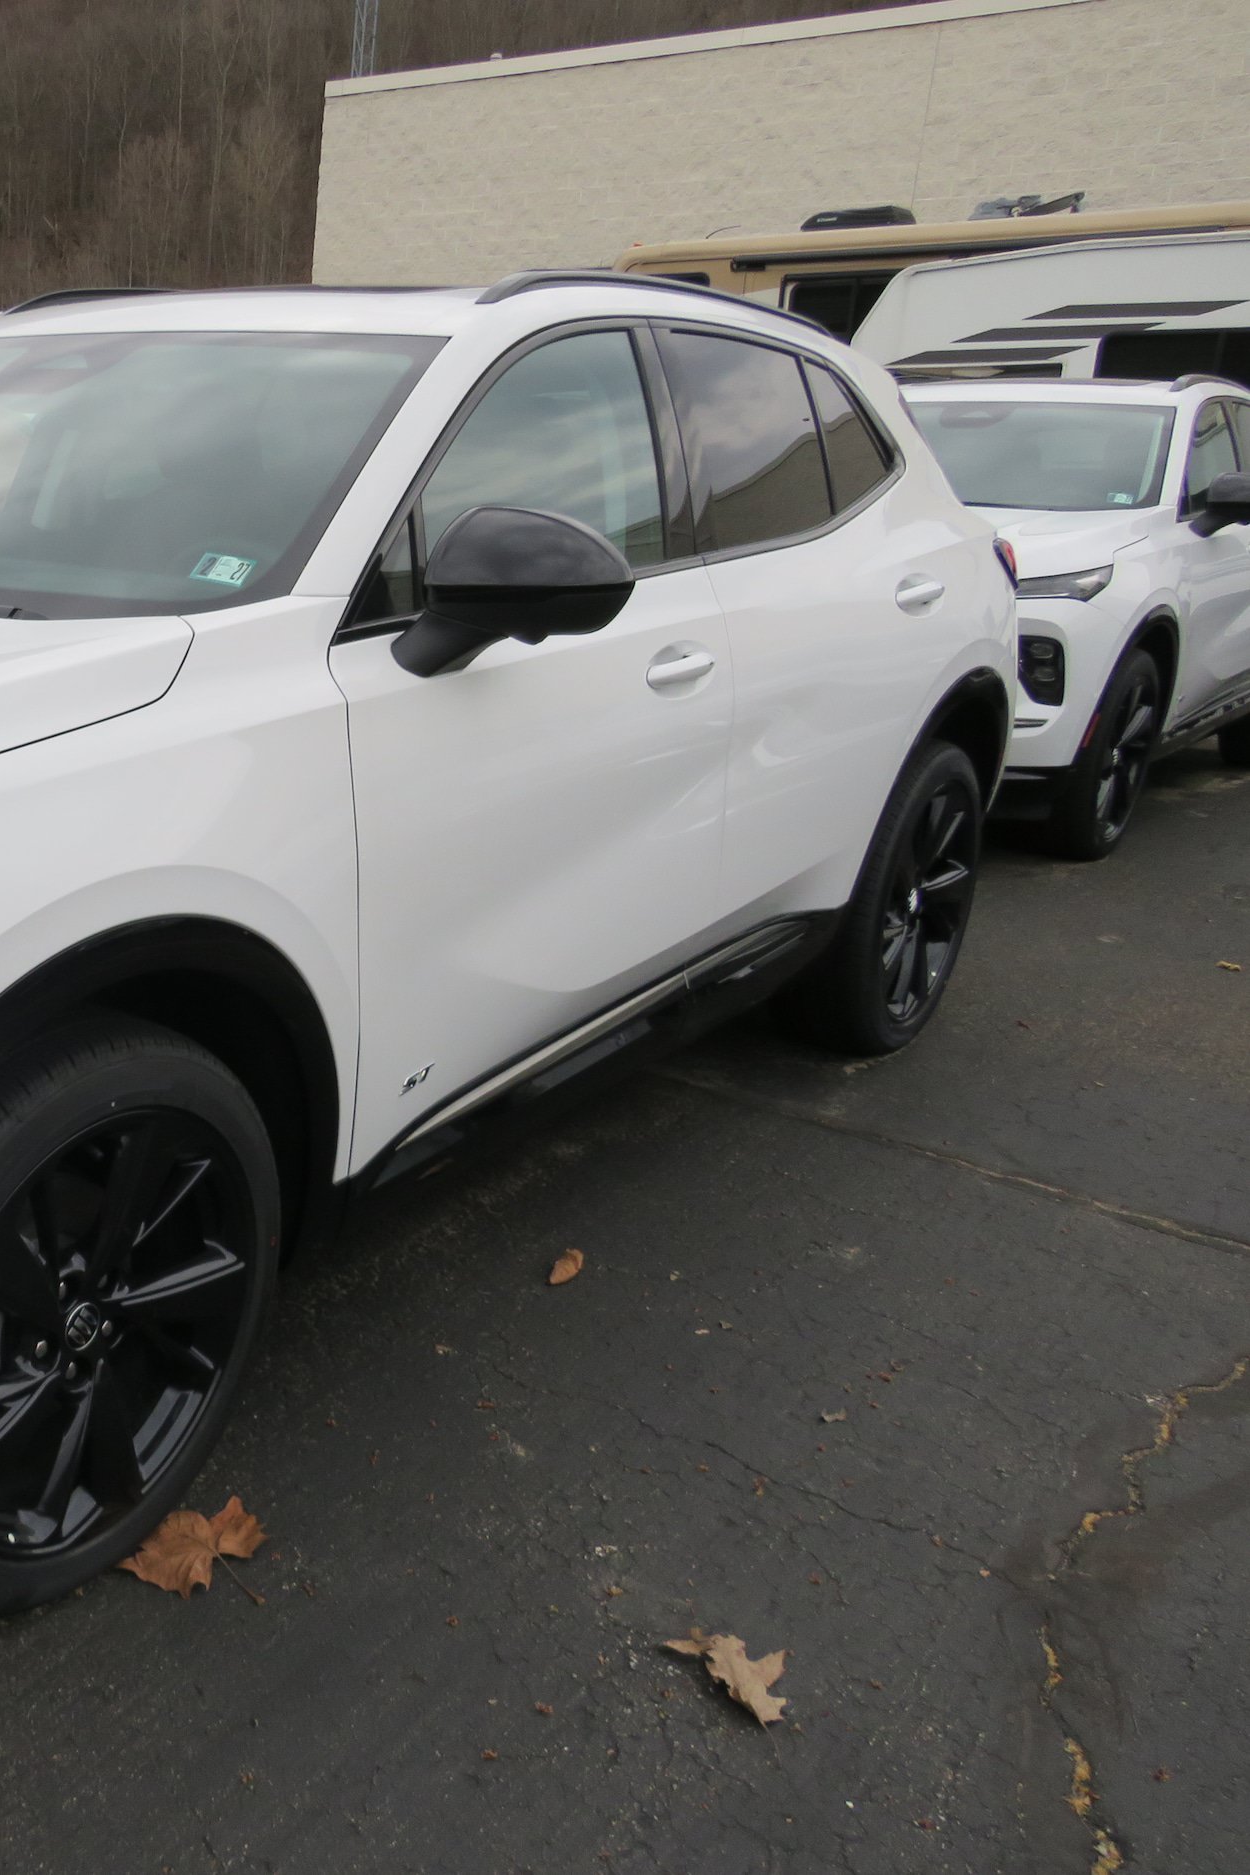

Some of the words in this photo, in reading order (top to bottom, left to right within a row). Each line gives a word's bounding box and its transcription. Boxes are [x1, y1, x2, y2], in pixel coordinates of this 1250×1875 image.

[199, 557, 217, 576] 2
[230, 562, 251, 582] 27
[399, 1062, 436, 1097] ST
